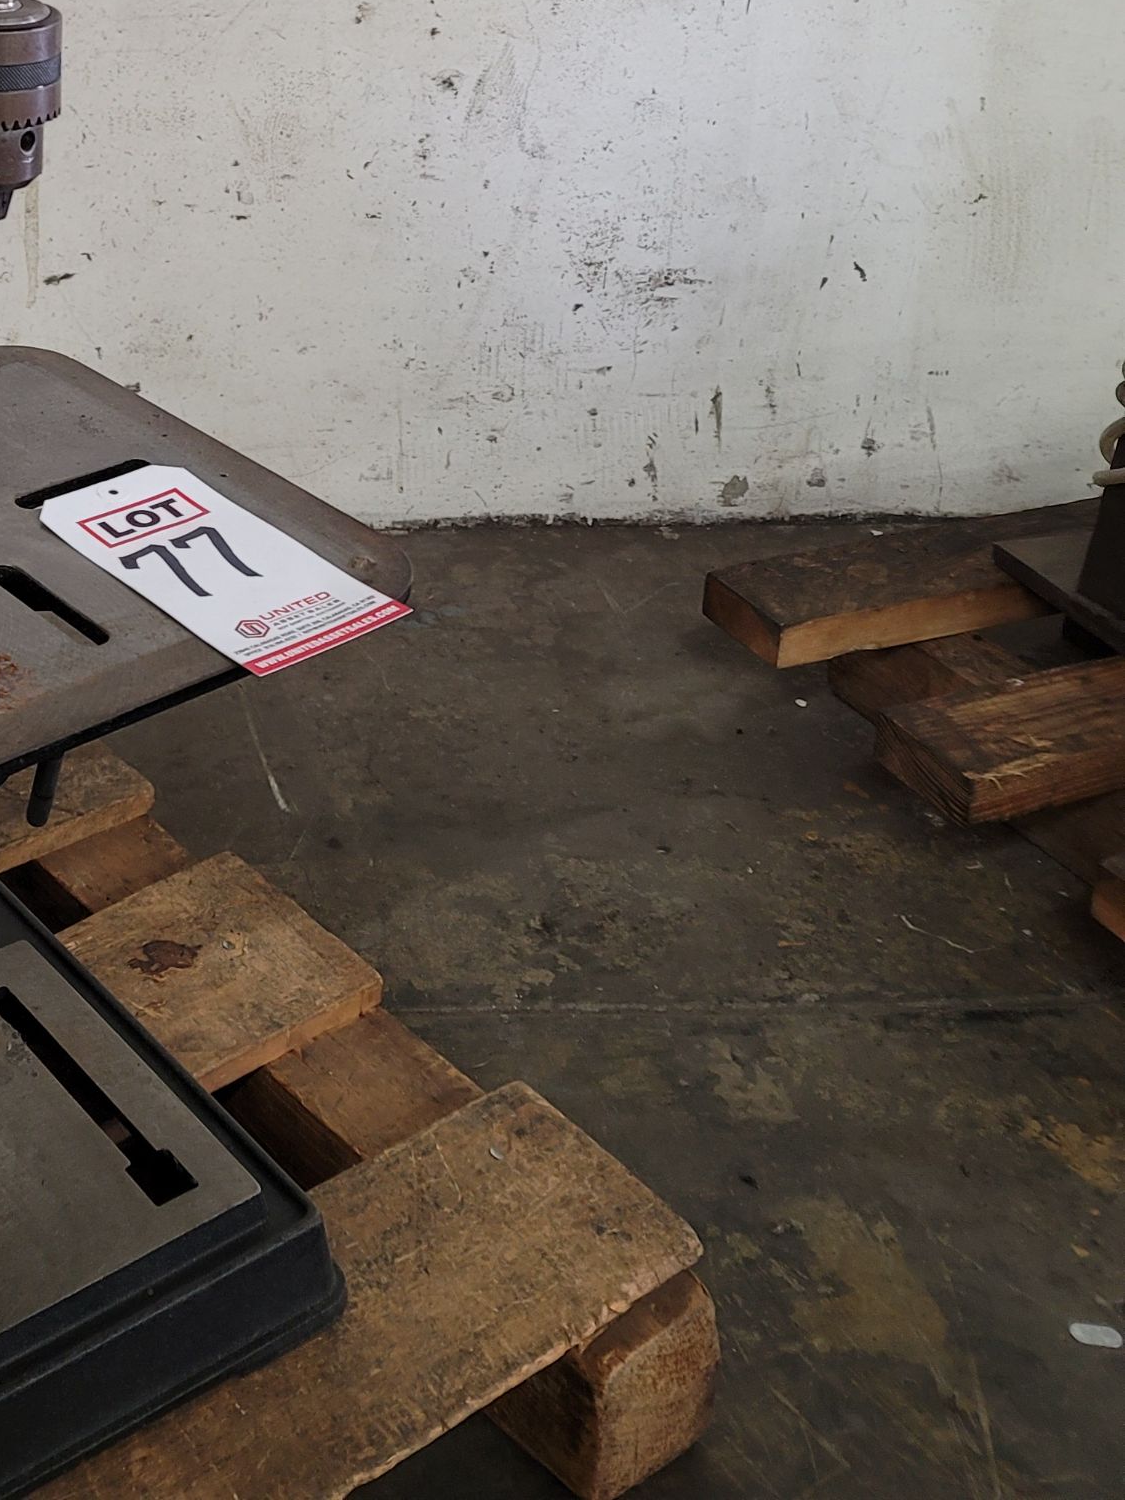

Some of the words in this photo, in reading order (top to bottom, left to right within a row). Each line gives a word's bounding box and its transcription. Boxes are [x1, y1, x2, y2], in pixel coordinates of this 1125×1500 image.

[97, 498, 185, 539] LOT
[119, 526, 265, 597] 77
[258, 591, 331, 620] UNITED
